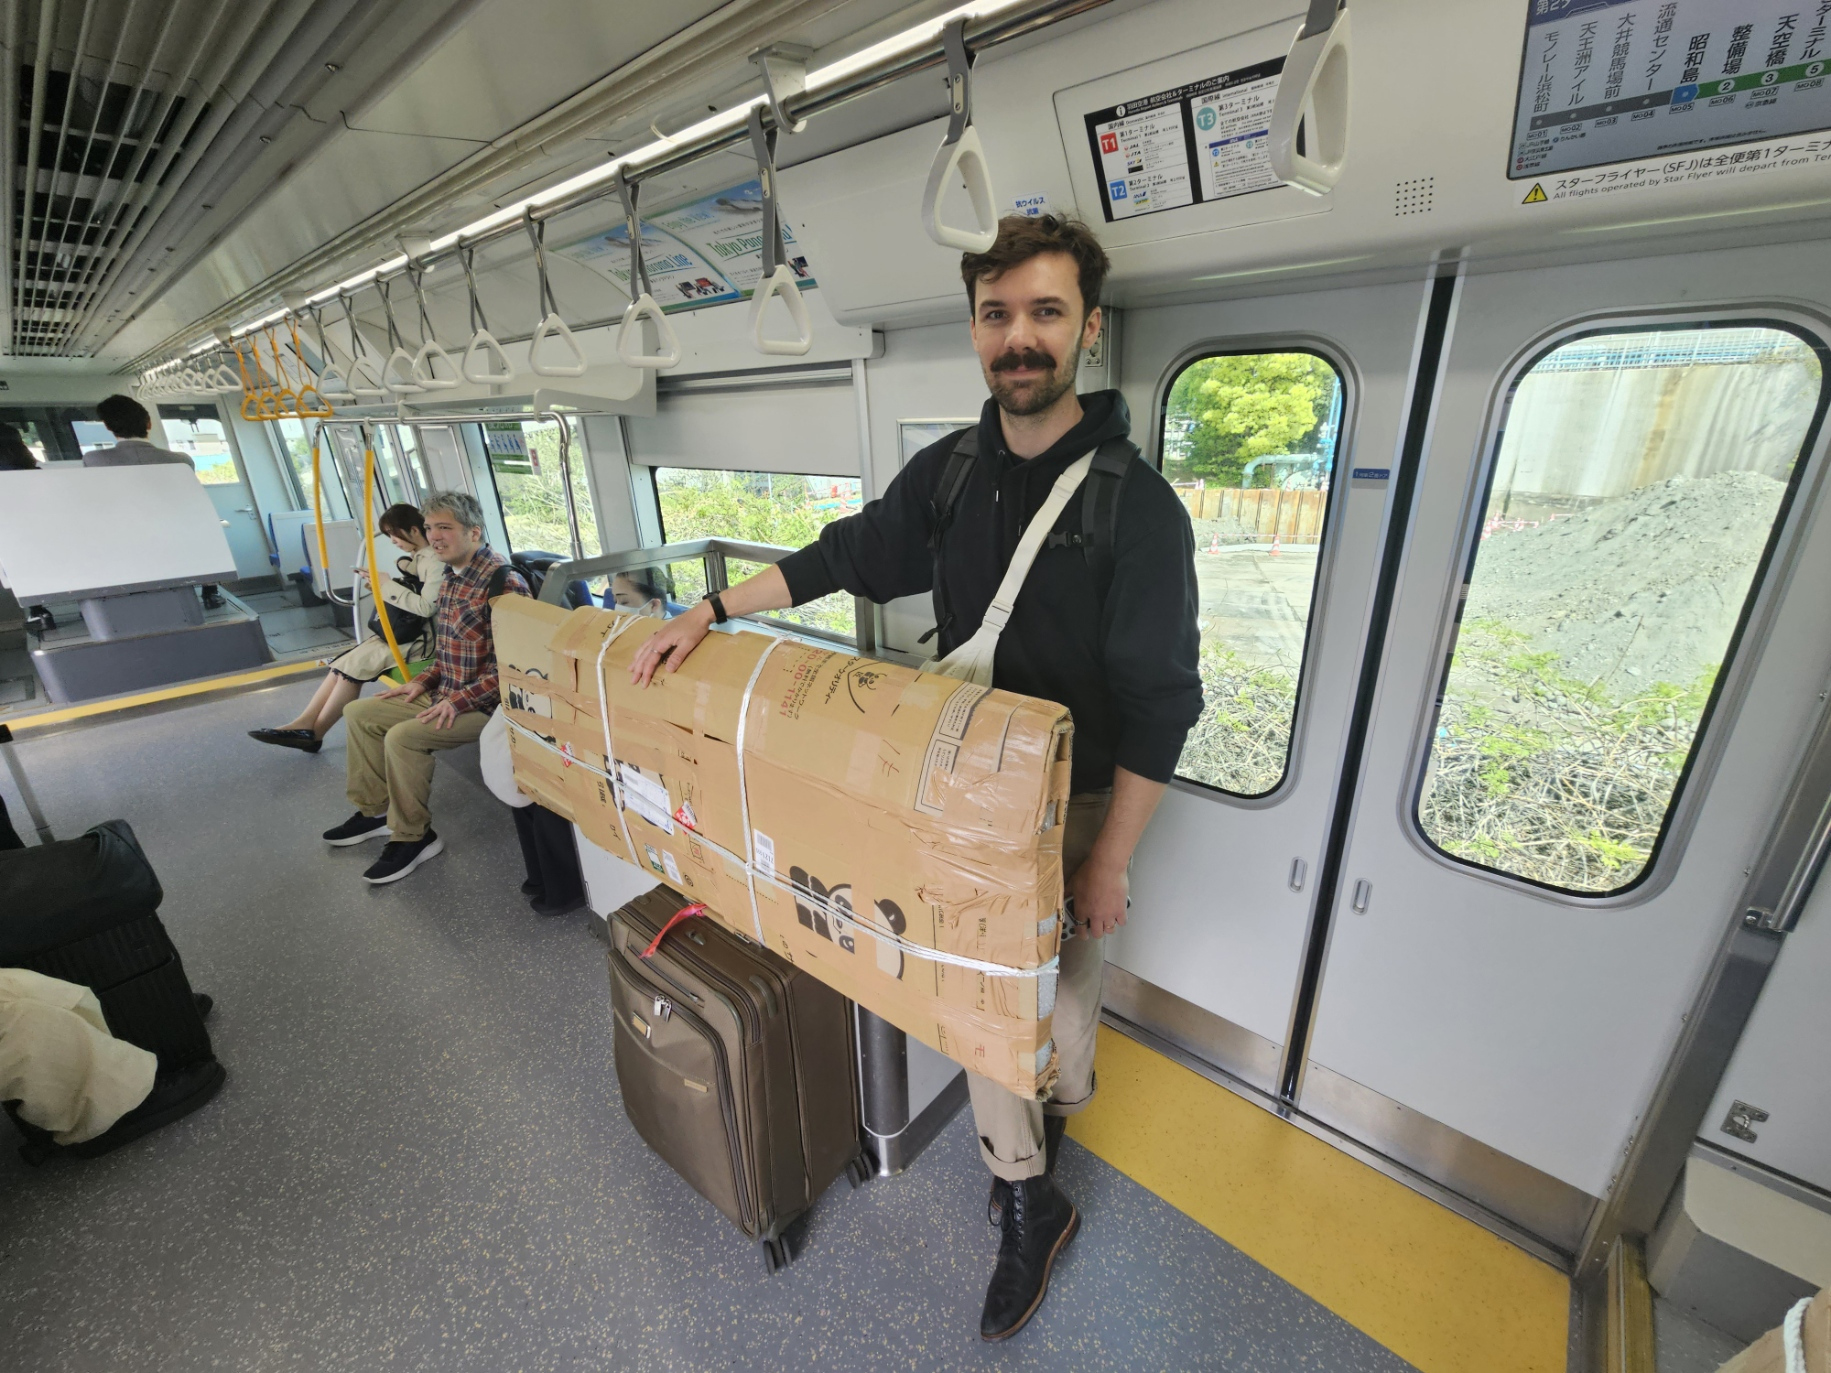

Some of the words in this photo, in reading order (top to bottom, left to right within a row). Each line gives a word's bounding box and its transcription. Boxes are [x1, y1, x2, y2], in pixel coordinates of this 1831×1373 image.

[1799, 0, 1831, 61] ターミナル
[1646, 2, 1678, 91] 流通センター
[1765, 13, 1800, 67] 天空橋
[1604, 12, 1636, 100] 大井競馬場前
[1721, 24, 1754, 75] 整備場
[1568, 21, 1598, 106] 天王洲アイル
[1680, 33, 1711, 84] 昭和島
[1533, 31, 1560, 113] モノレール浜松町
[1810, 64, 1819, 74] 5
[1764, 73, 1774, 83] 3
[1722, 82, 1731, 91] 2
[1218, 95, 1260, 111] 第3ターミナル
[1199, 113, 1214, 127] T3
[1120, 124, 1155, 138] 第1ターミナル
[1102, 137, 1116, 151] T1
[1128, 174, 1163, 187] 第2ターミナル
[1553, 192, 1566, 200] All
[1568, 187, 1598, 197] flights
[1601, 181, 1645, 194] operated
[1649, 178, 1660, 187] by
[1664, 174, 1683, 183] Star
[1687, 170, 1713, 181] Flyer
[1715, 166, 1736, 176] will
[1739, 161, 1776, 174] depart
[1781, 157, 1809, 167] from
[1112, 185, 1126, 198] T2
[1015, 196, 1045, 208] 抗ウイルス
[706, 240, 742, 257] Tokyo
